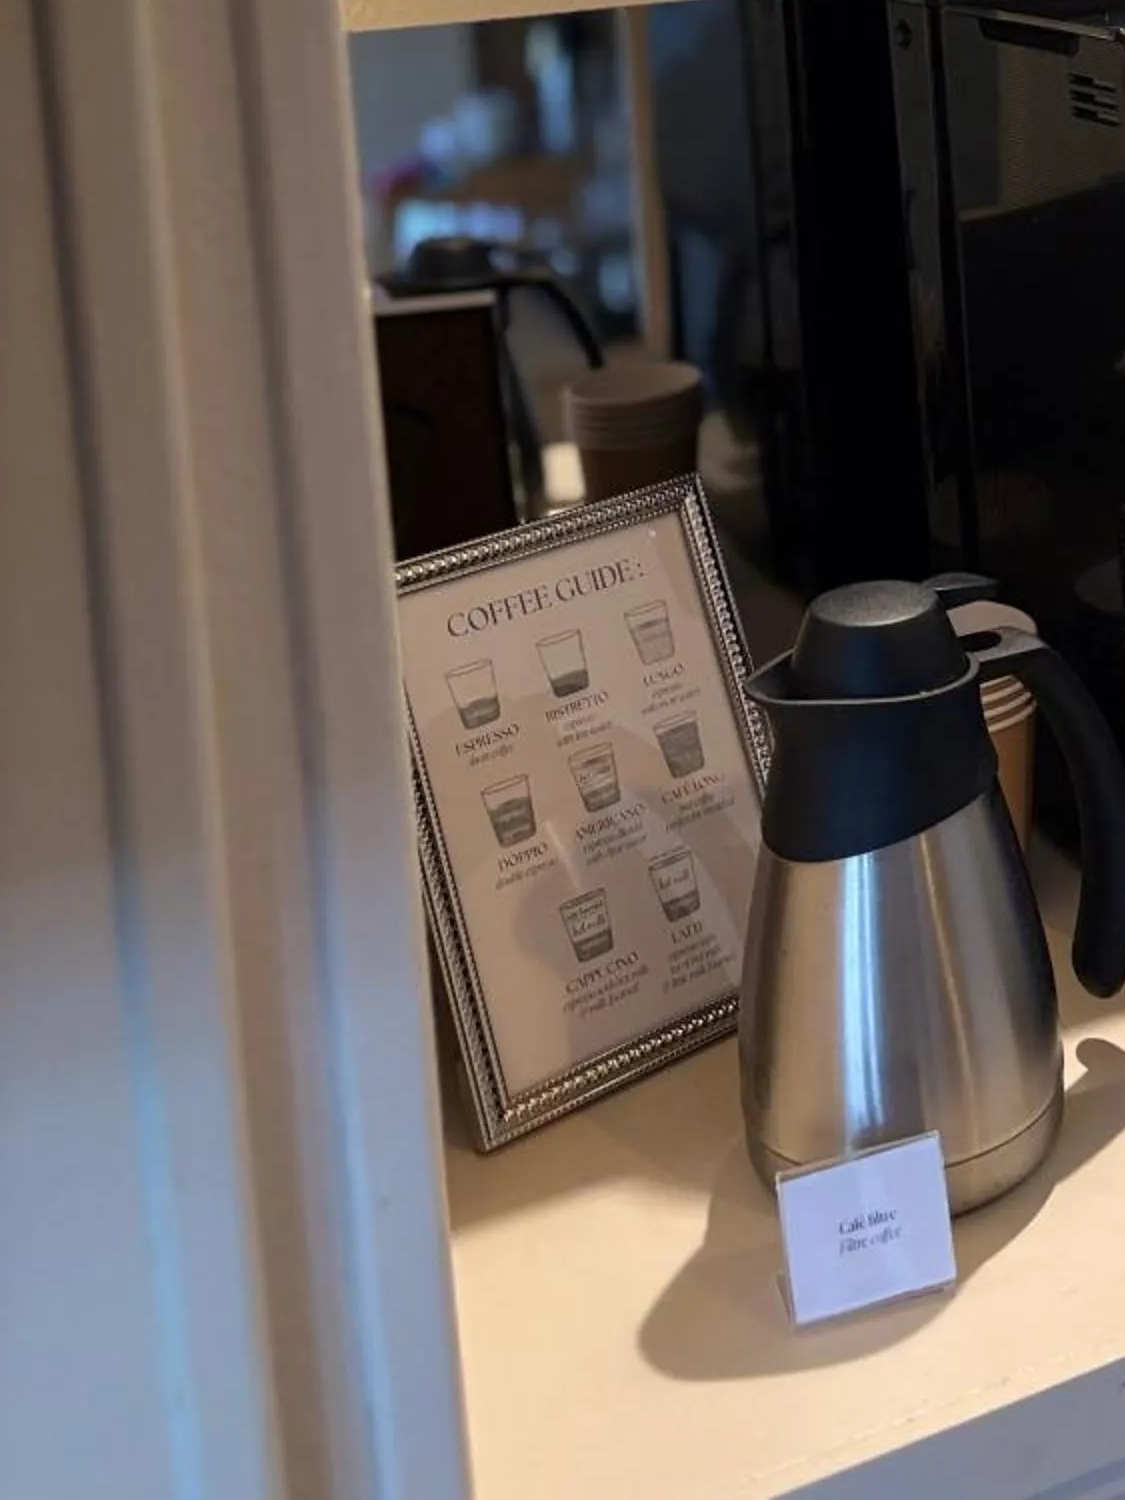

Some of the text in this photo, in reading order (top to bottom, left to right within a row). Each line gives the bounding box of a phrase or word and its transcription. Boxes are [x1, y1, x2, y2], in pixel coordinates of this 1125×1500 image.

[446, 557, 648, 638] COFFEE GUIDE:
[455, 723, 520, 757] ESPRESSO
[498, 842, 548, 872] DOPPIO
